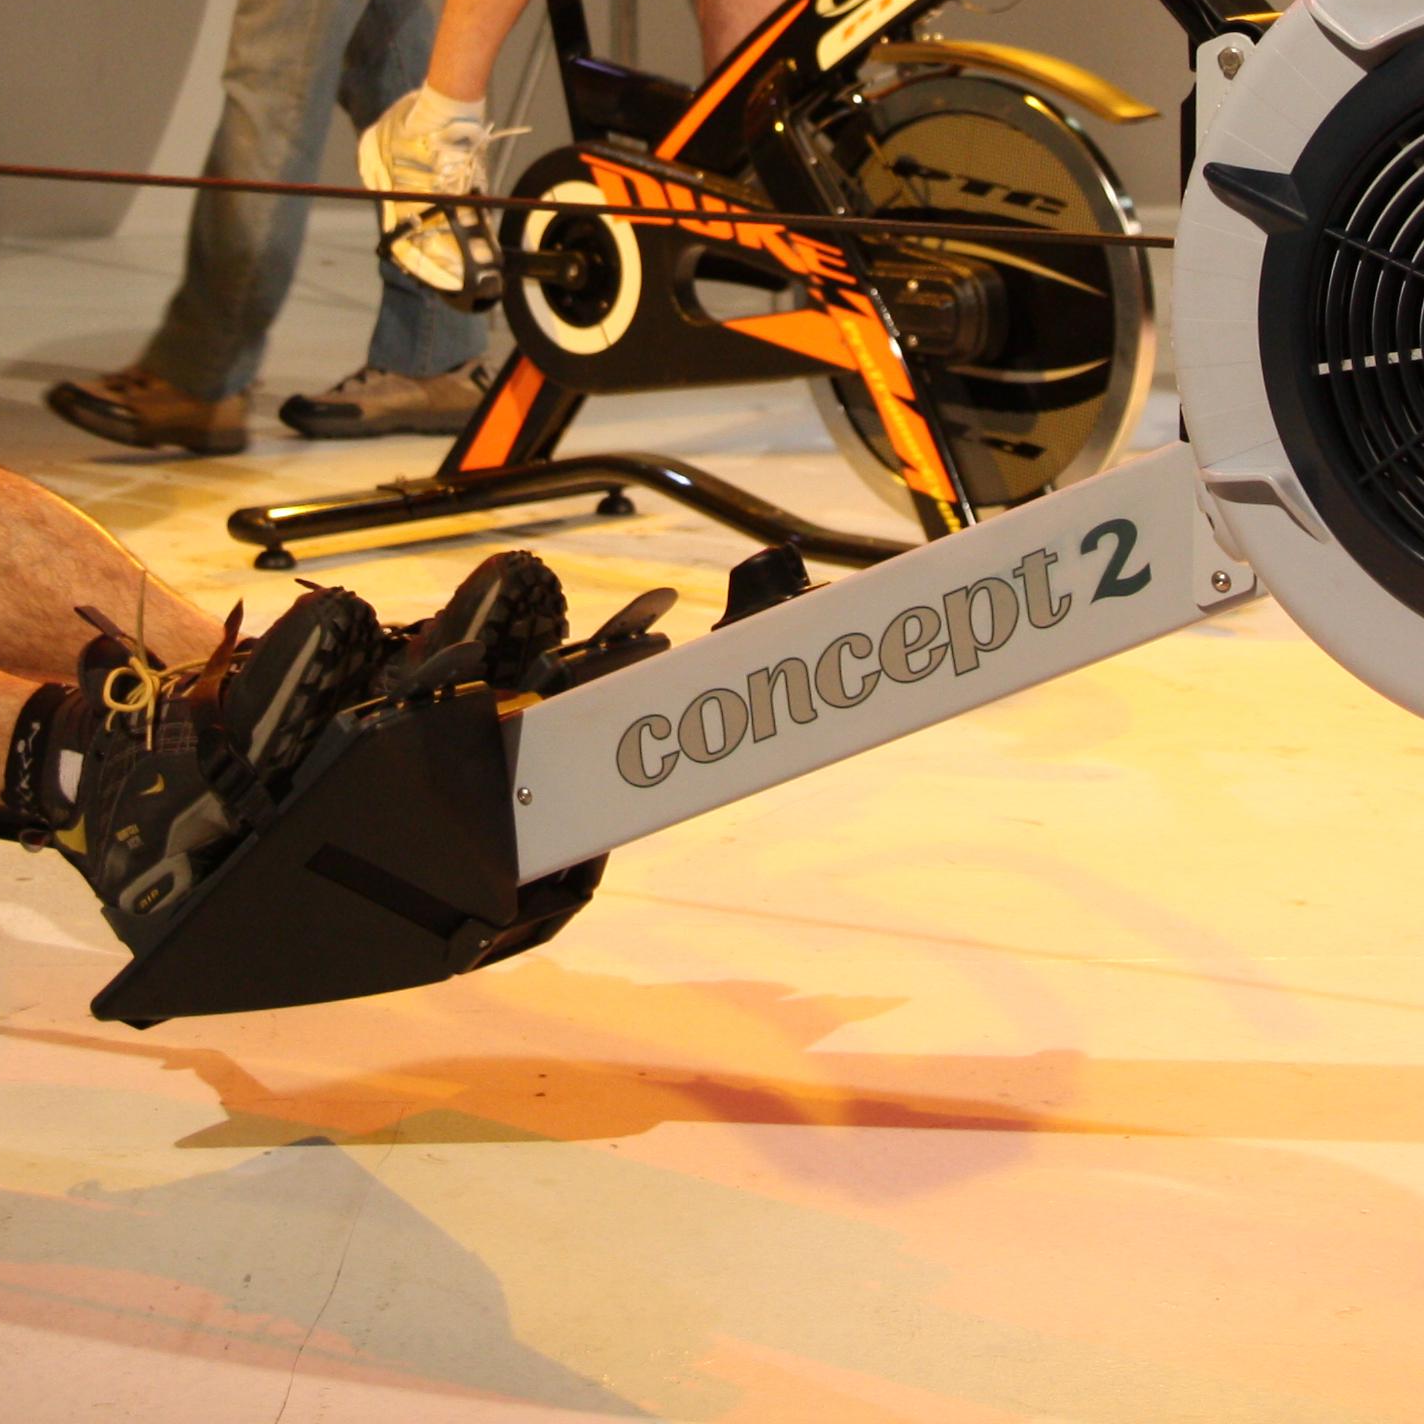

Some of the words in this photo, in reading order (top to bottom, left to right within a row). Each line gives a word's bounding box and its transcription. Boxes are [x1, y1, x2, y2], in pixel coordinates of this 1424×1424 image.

[579, 153, 858, 285] DUKE
[616, 548, 1073, 788] concept
[1080, 518, 1153, 604] 2
